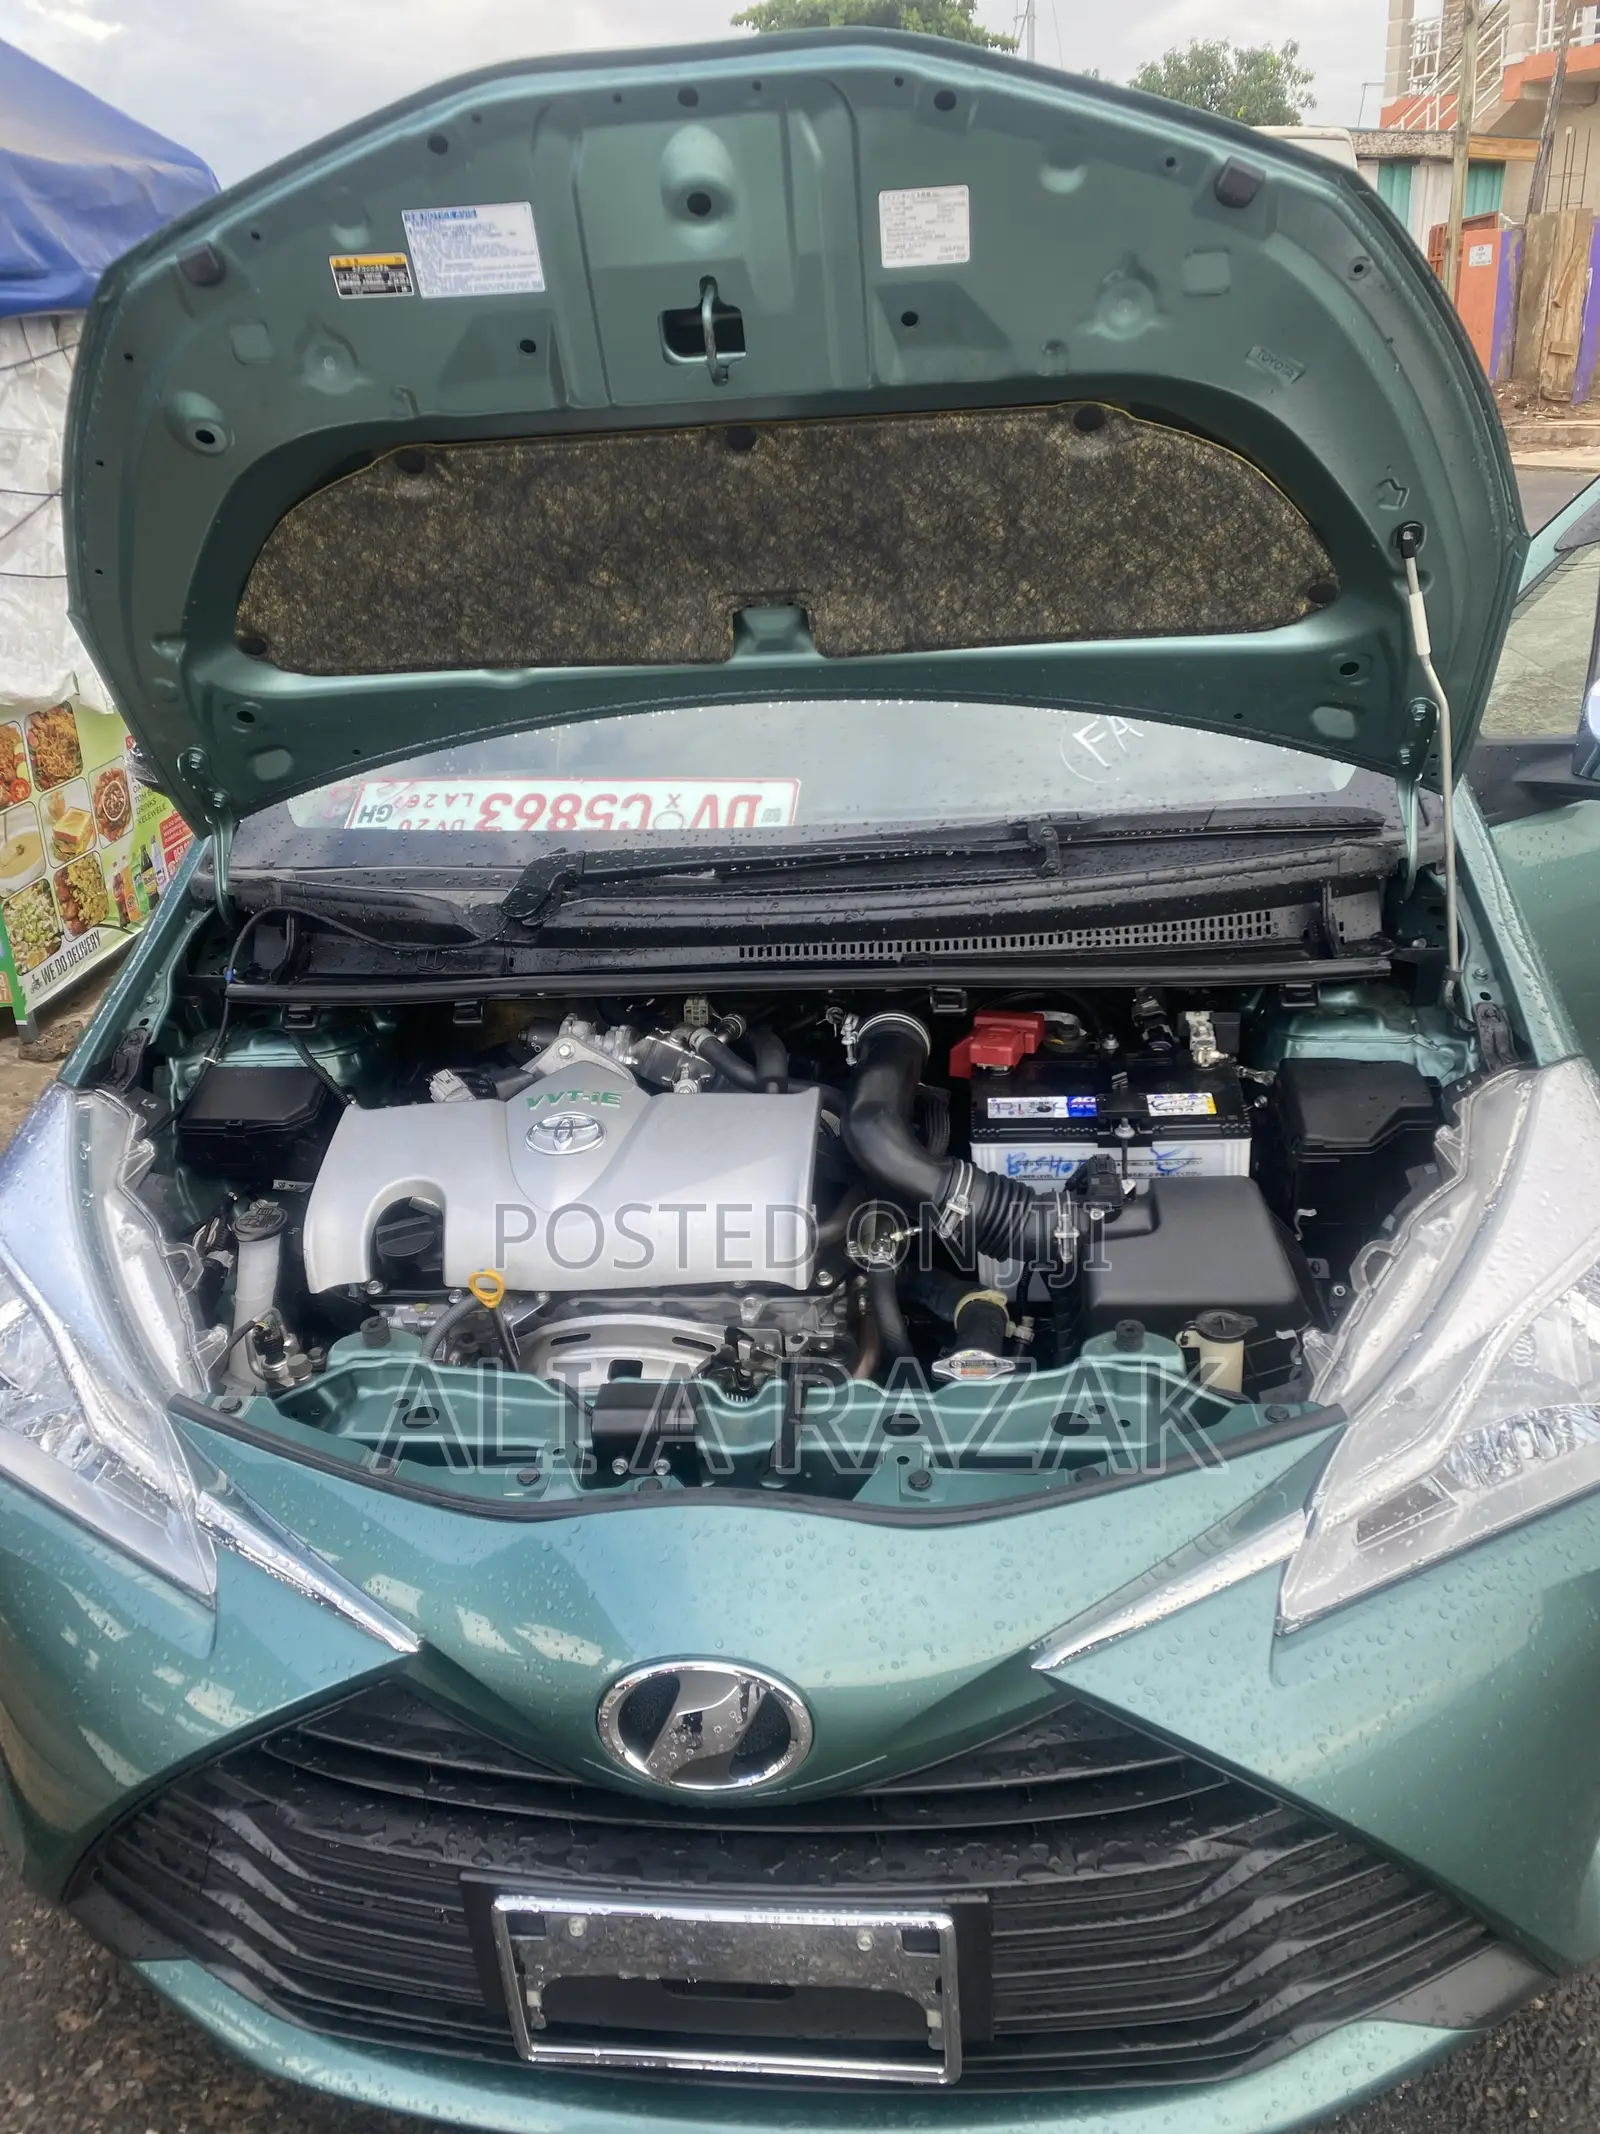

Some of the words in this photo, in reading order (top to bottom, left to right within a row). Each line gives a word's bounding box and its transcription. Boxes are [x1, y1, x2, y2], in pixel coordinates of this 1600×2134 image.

[1257, 349, 1295, 380] TOYOTA
[136, 797, 157, 815] DRINKS
[357, 804, 393, 824] GH
[476, 792, 653, 831] C5863
[692, 794, 763, 830] DV
[40, 962, 57, 985] WE
[54, 954, 68, 976] DO
[66, 930, 101, 968] DELIVERY
